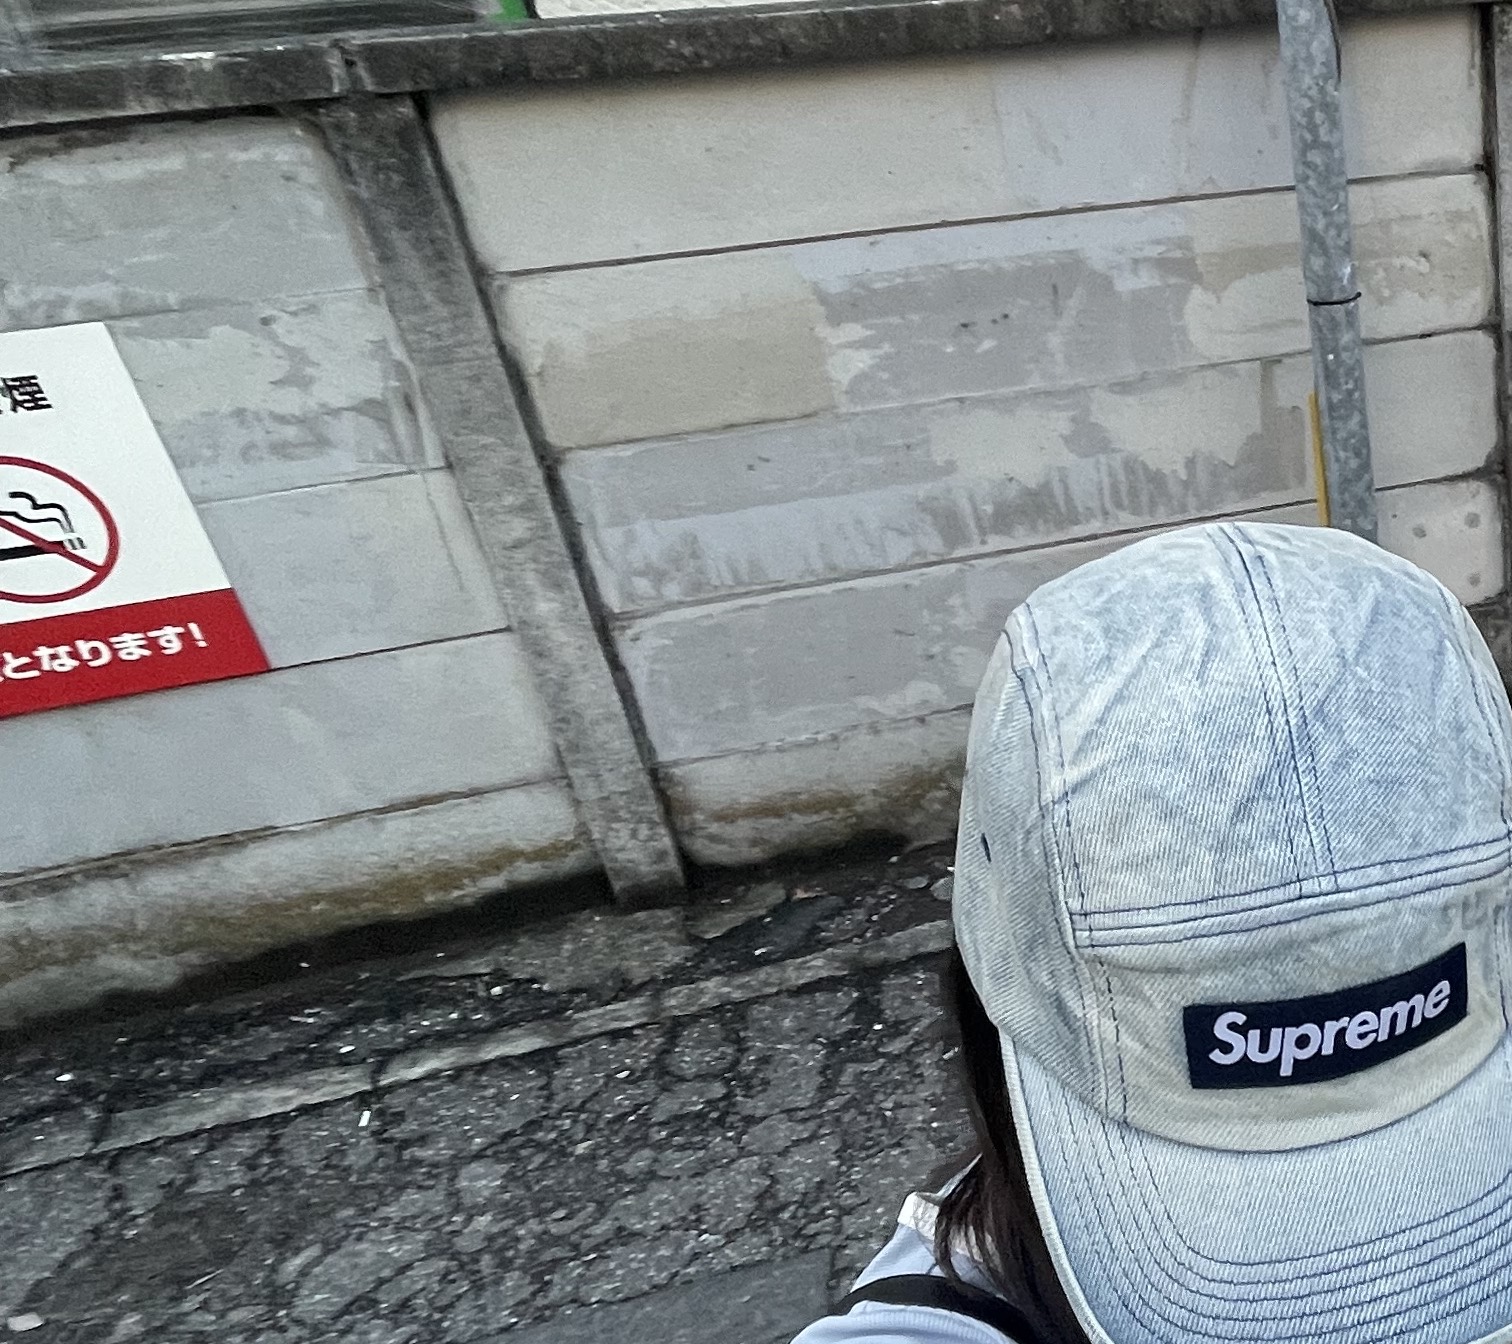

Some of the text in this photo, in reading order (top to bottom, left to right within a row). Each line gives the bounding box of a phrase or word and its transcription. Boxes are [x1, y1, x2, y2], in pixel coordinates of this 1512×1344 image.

[0, 622, 209, 683] となります!
[1208, 979, 1451, 1077] Supreme
